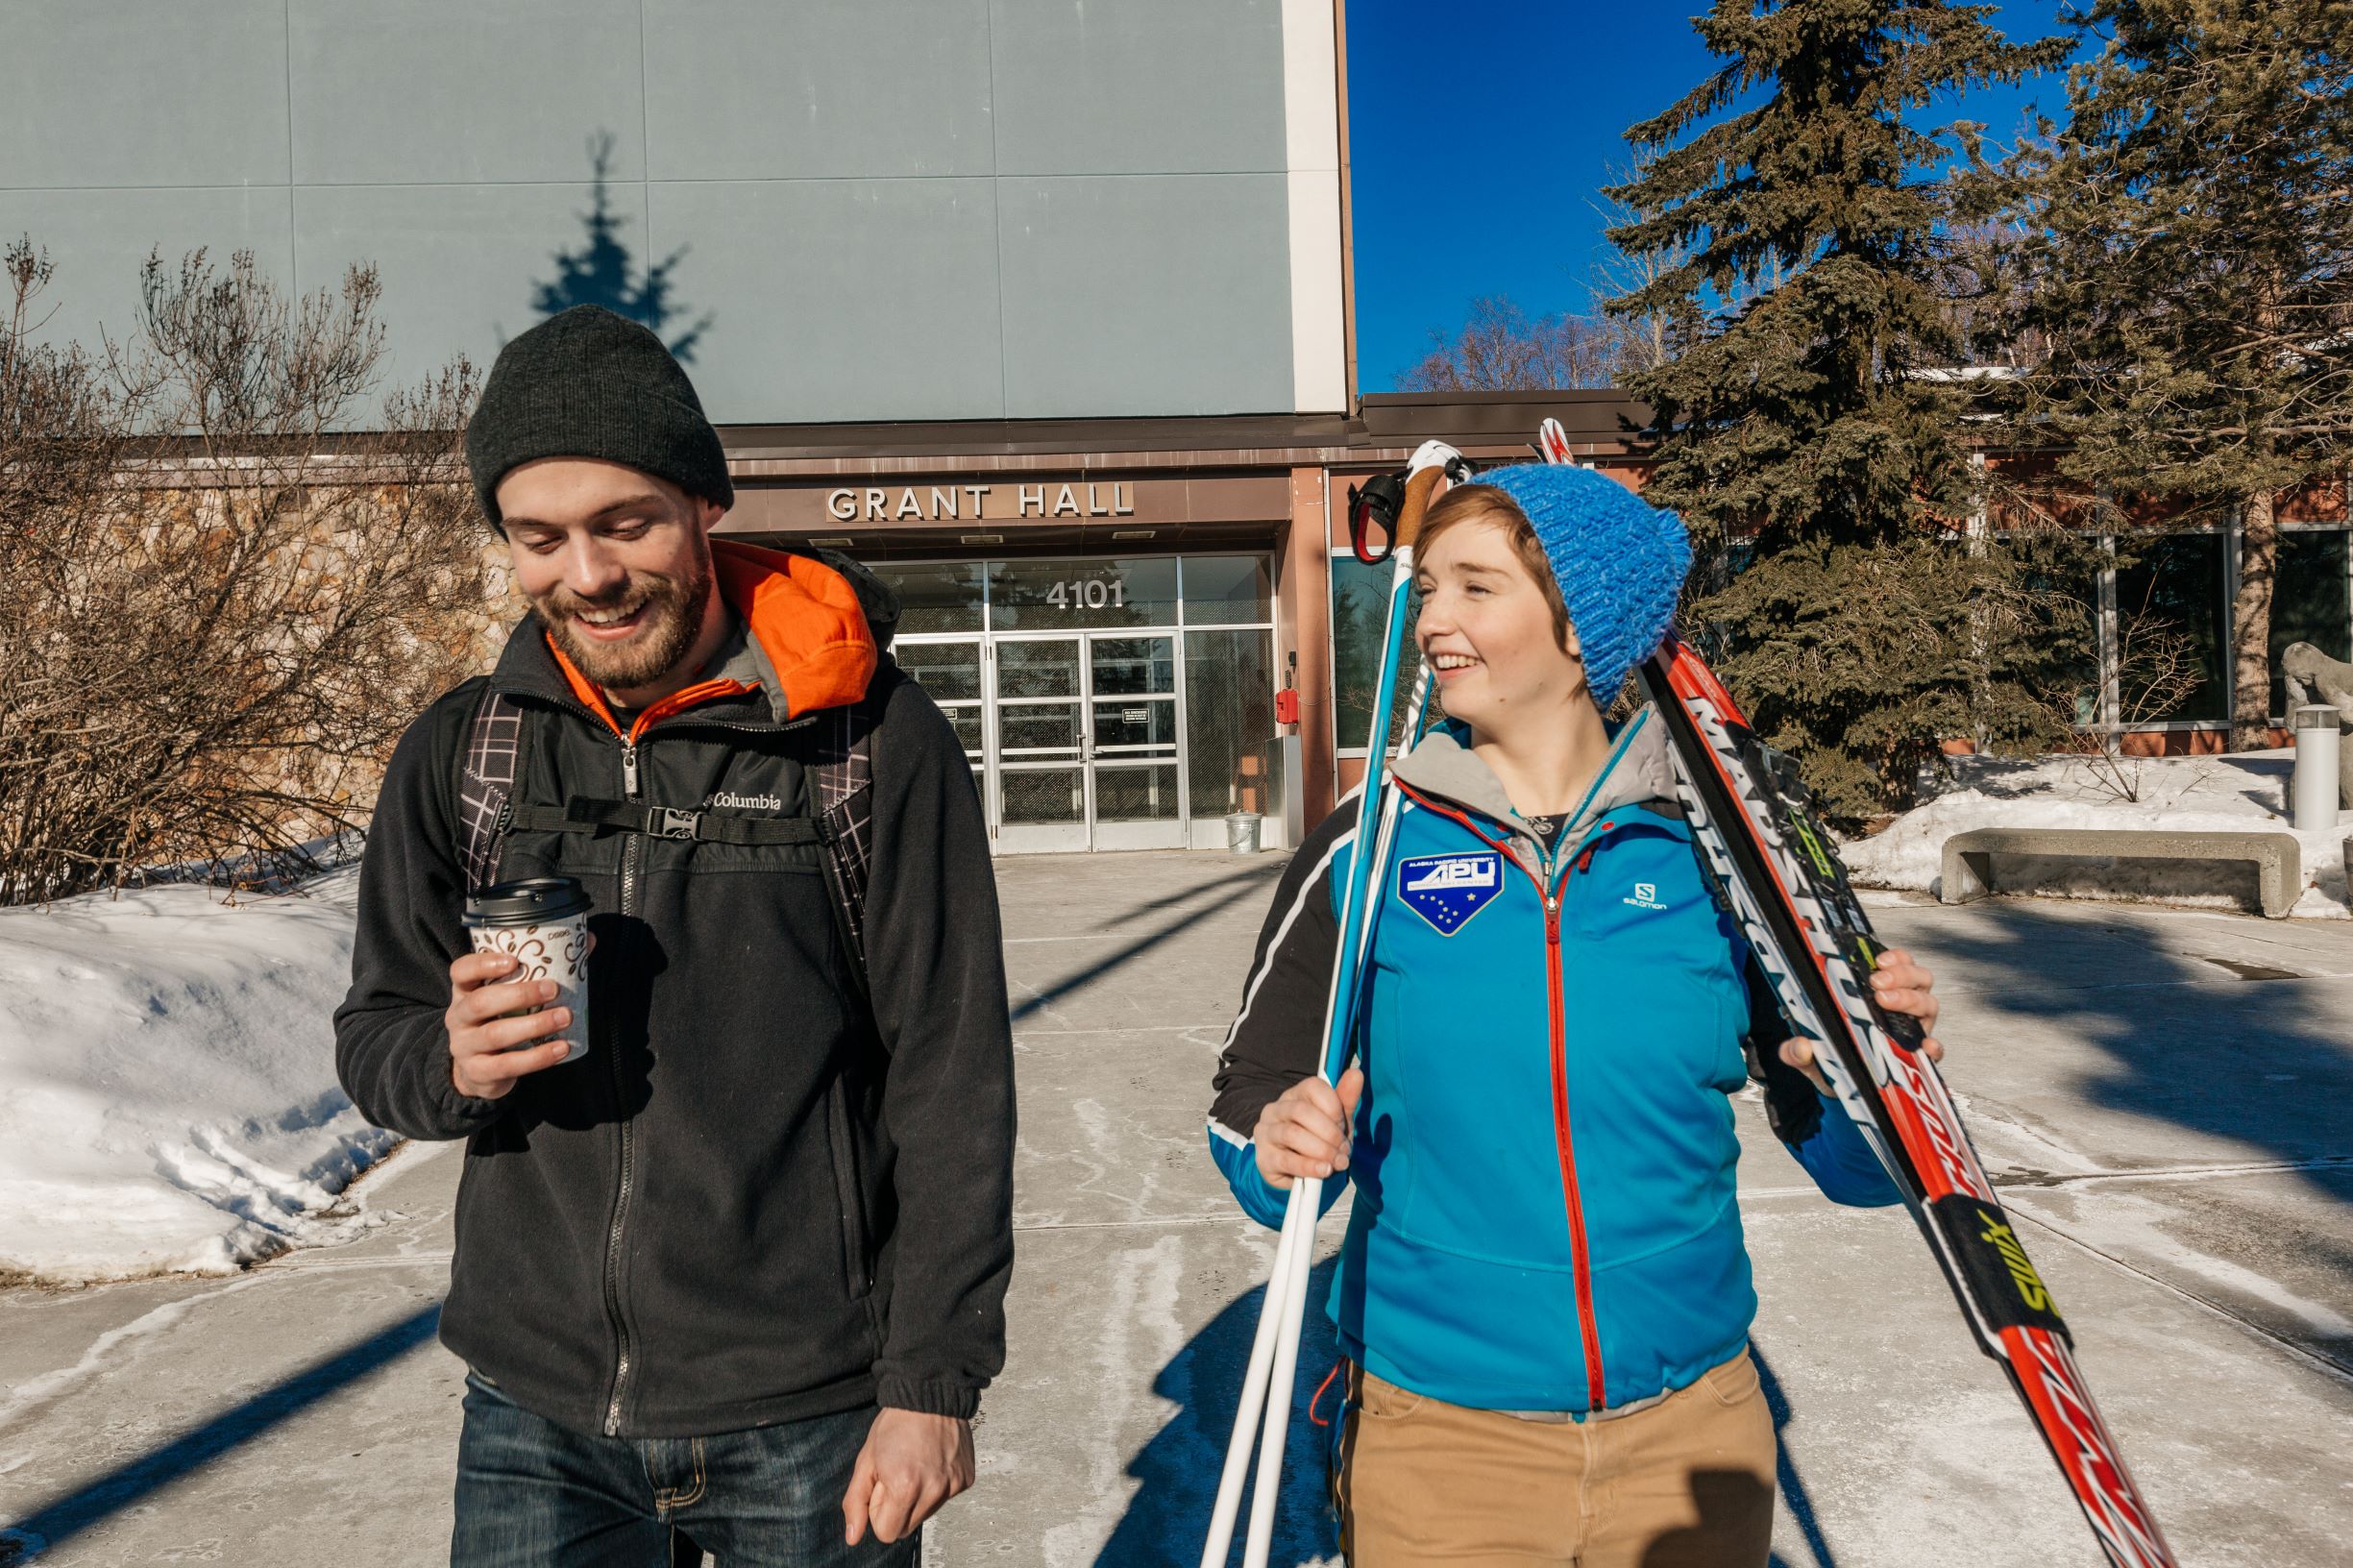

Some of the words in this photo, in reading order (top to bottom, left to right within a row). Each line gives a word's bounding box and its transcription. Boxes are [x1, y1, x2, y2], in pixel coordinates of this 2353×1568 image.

[827, 485, 991, 520] GRANT
[1018, 482, 1134, 517] HALL
[1046, 579, 1123, 609] 4101
[713, 792, 781, 811] Columbia
